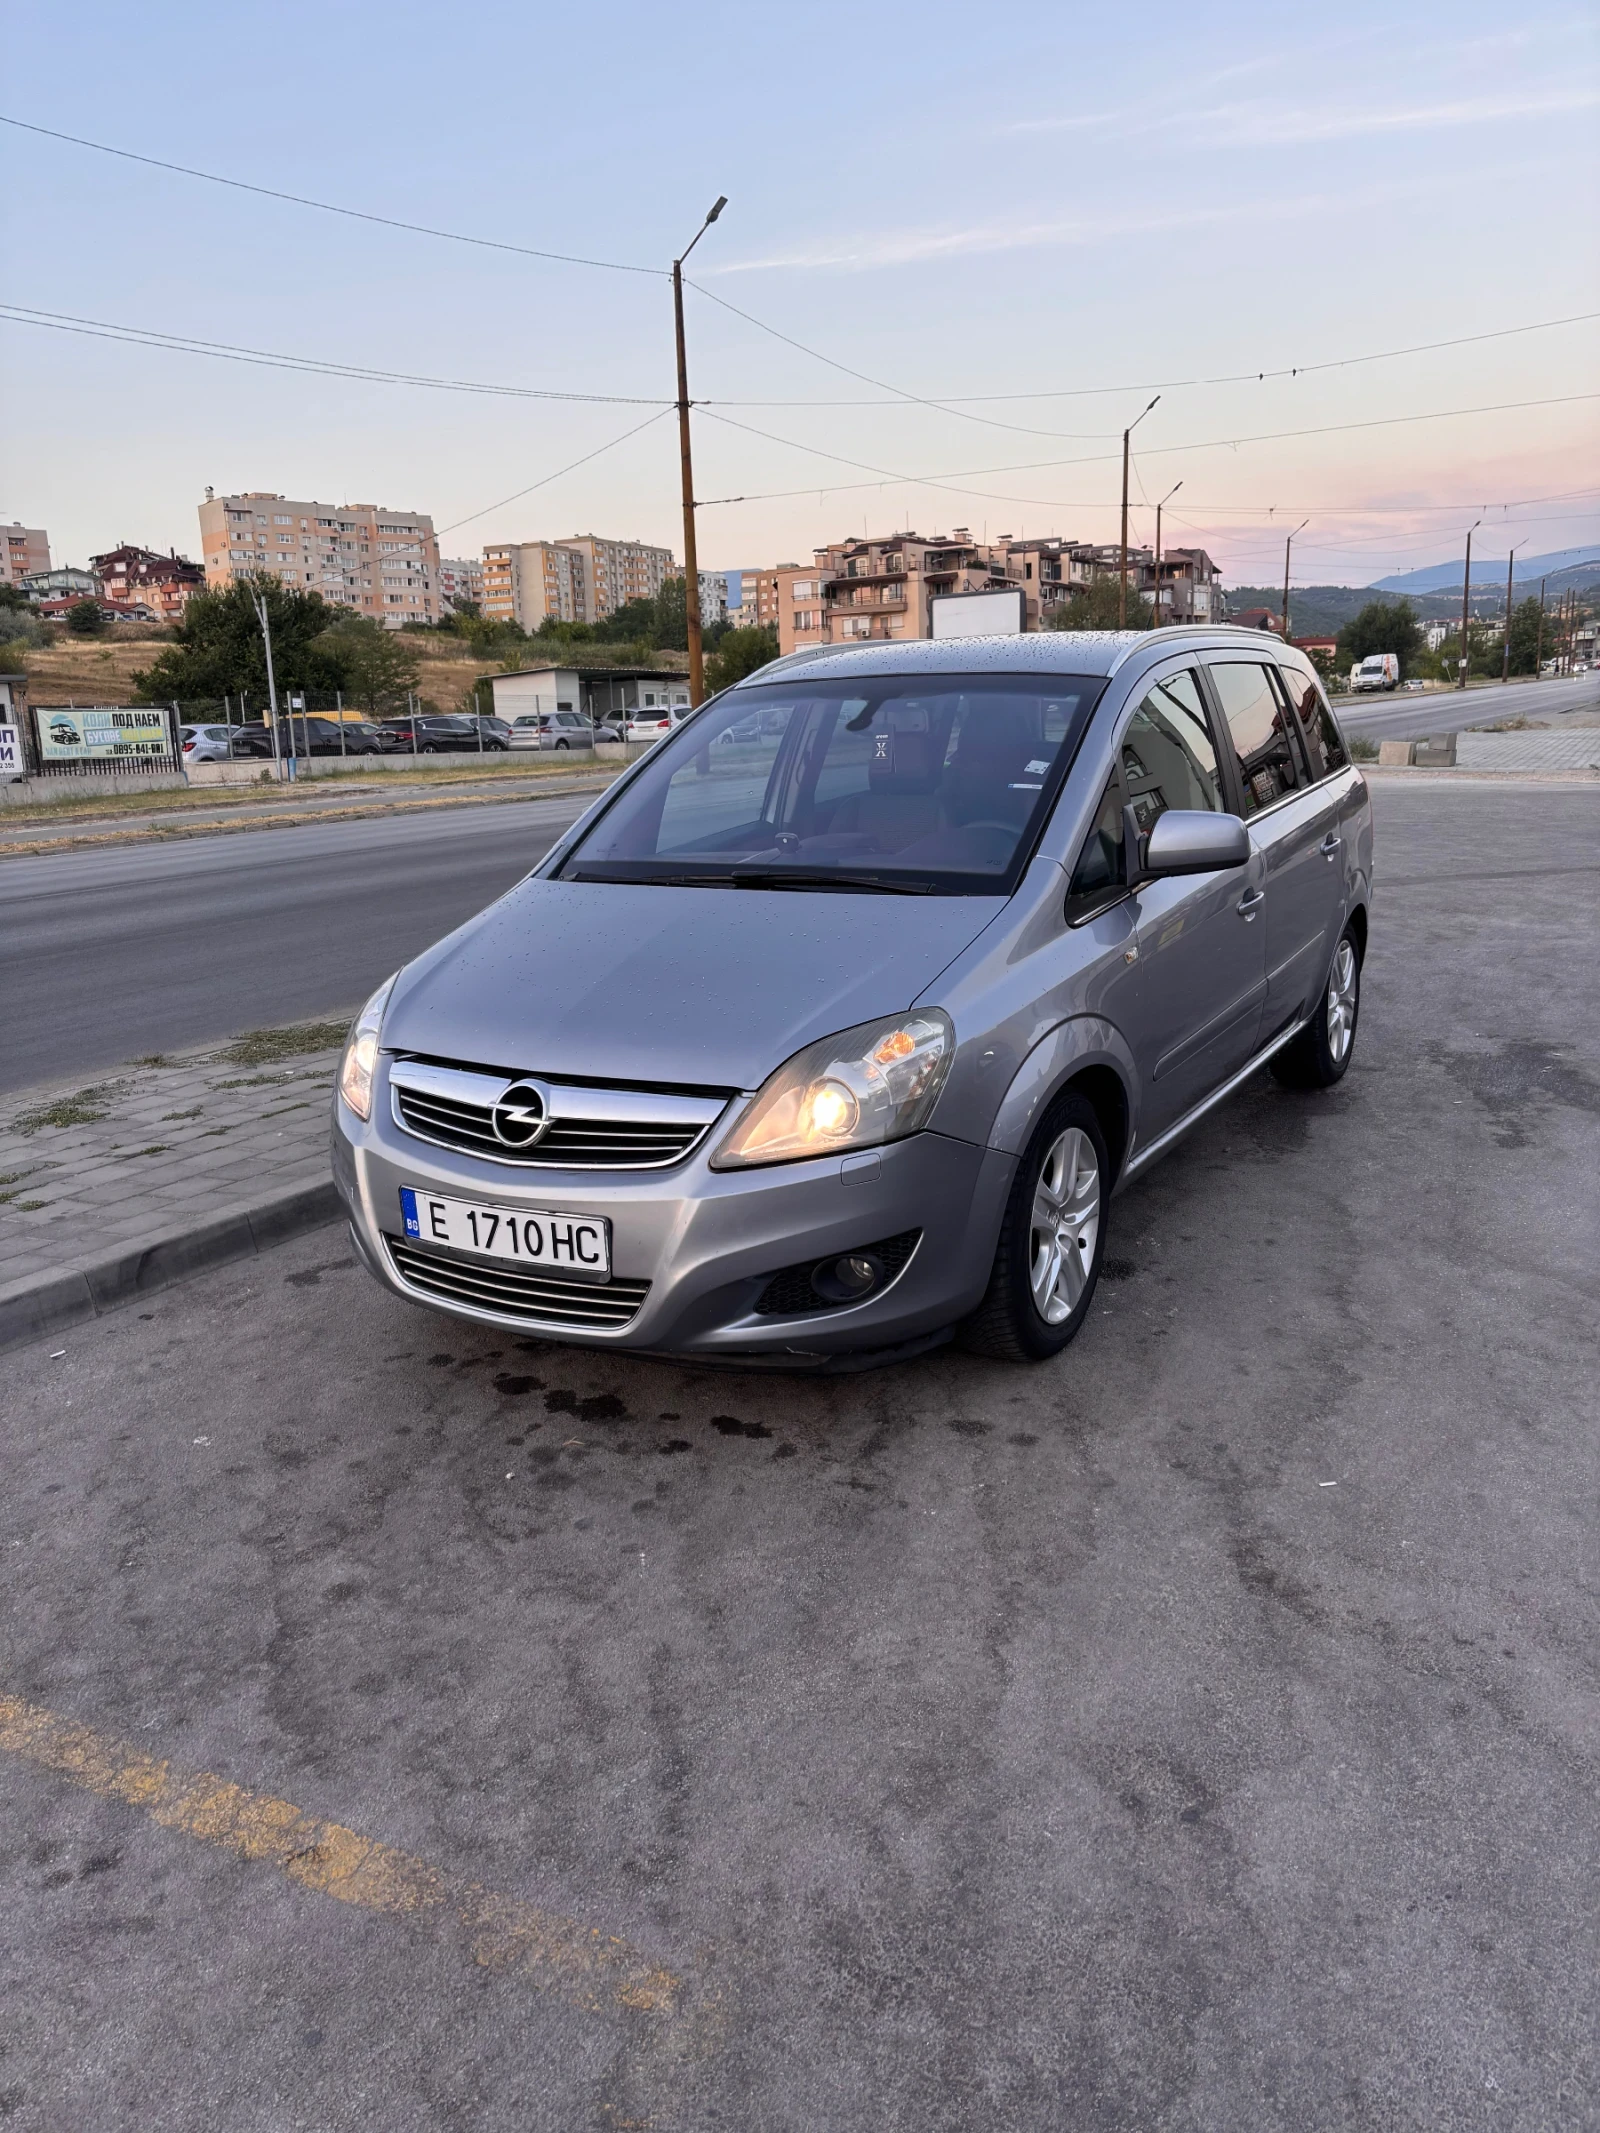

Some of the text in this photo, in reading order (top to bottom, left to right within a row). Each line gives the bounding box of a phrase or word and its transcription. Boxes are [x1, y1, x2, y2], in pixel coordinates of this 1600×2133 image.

[83, 713, 160, 728] КОЛИ ПОД НАЕМ
[0, 729, 15, 743] П
[87, 730, 120, 744] БУСОВЕ
[406, 1218, 419, 1231] BG
[429, 1201, 450, 1241] E
